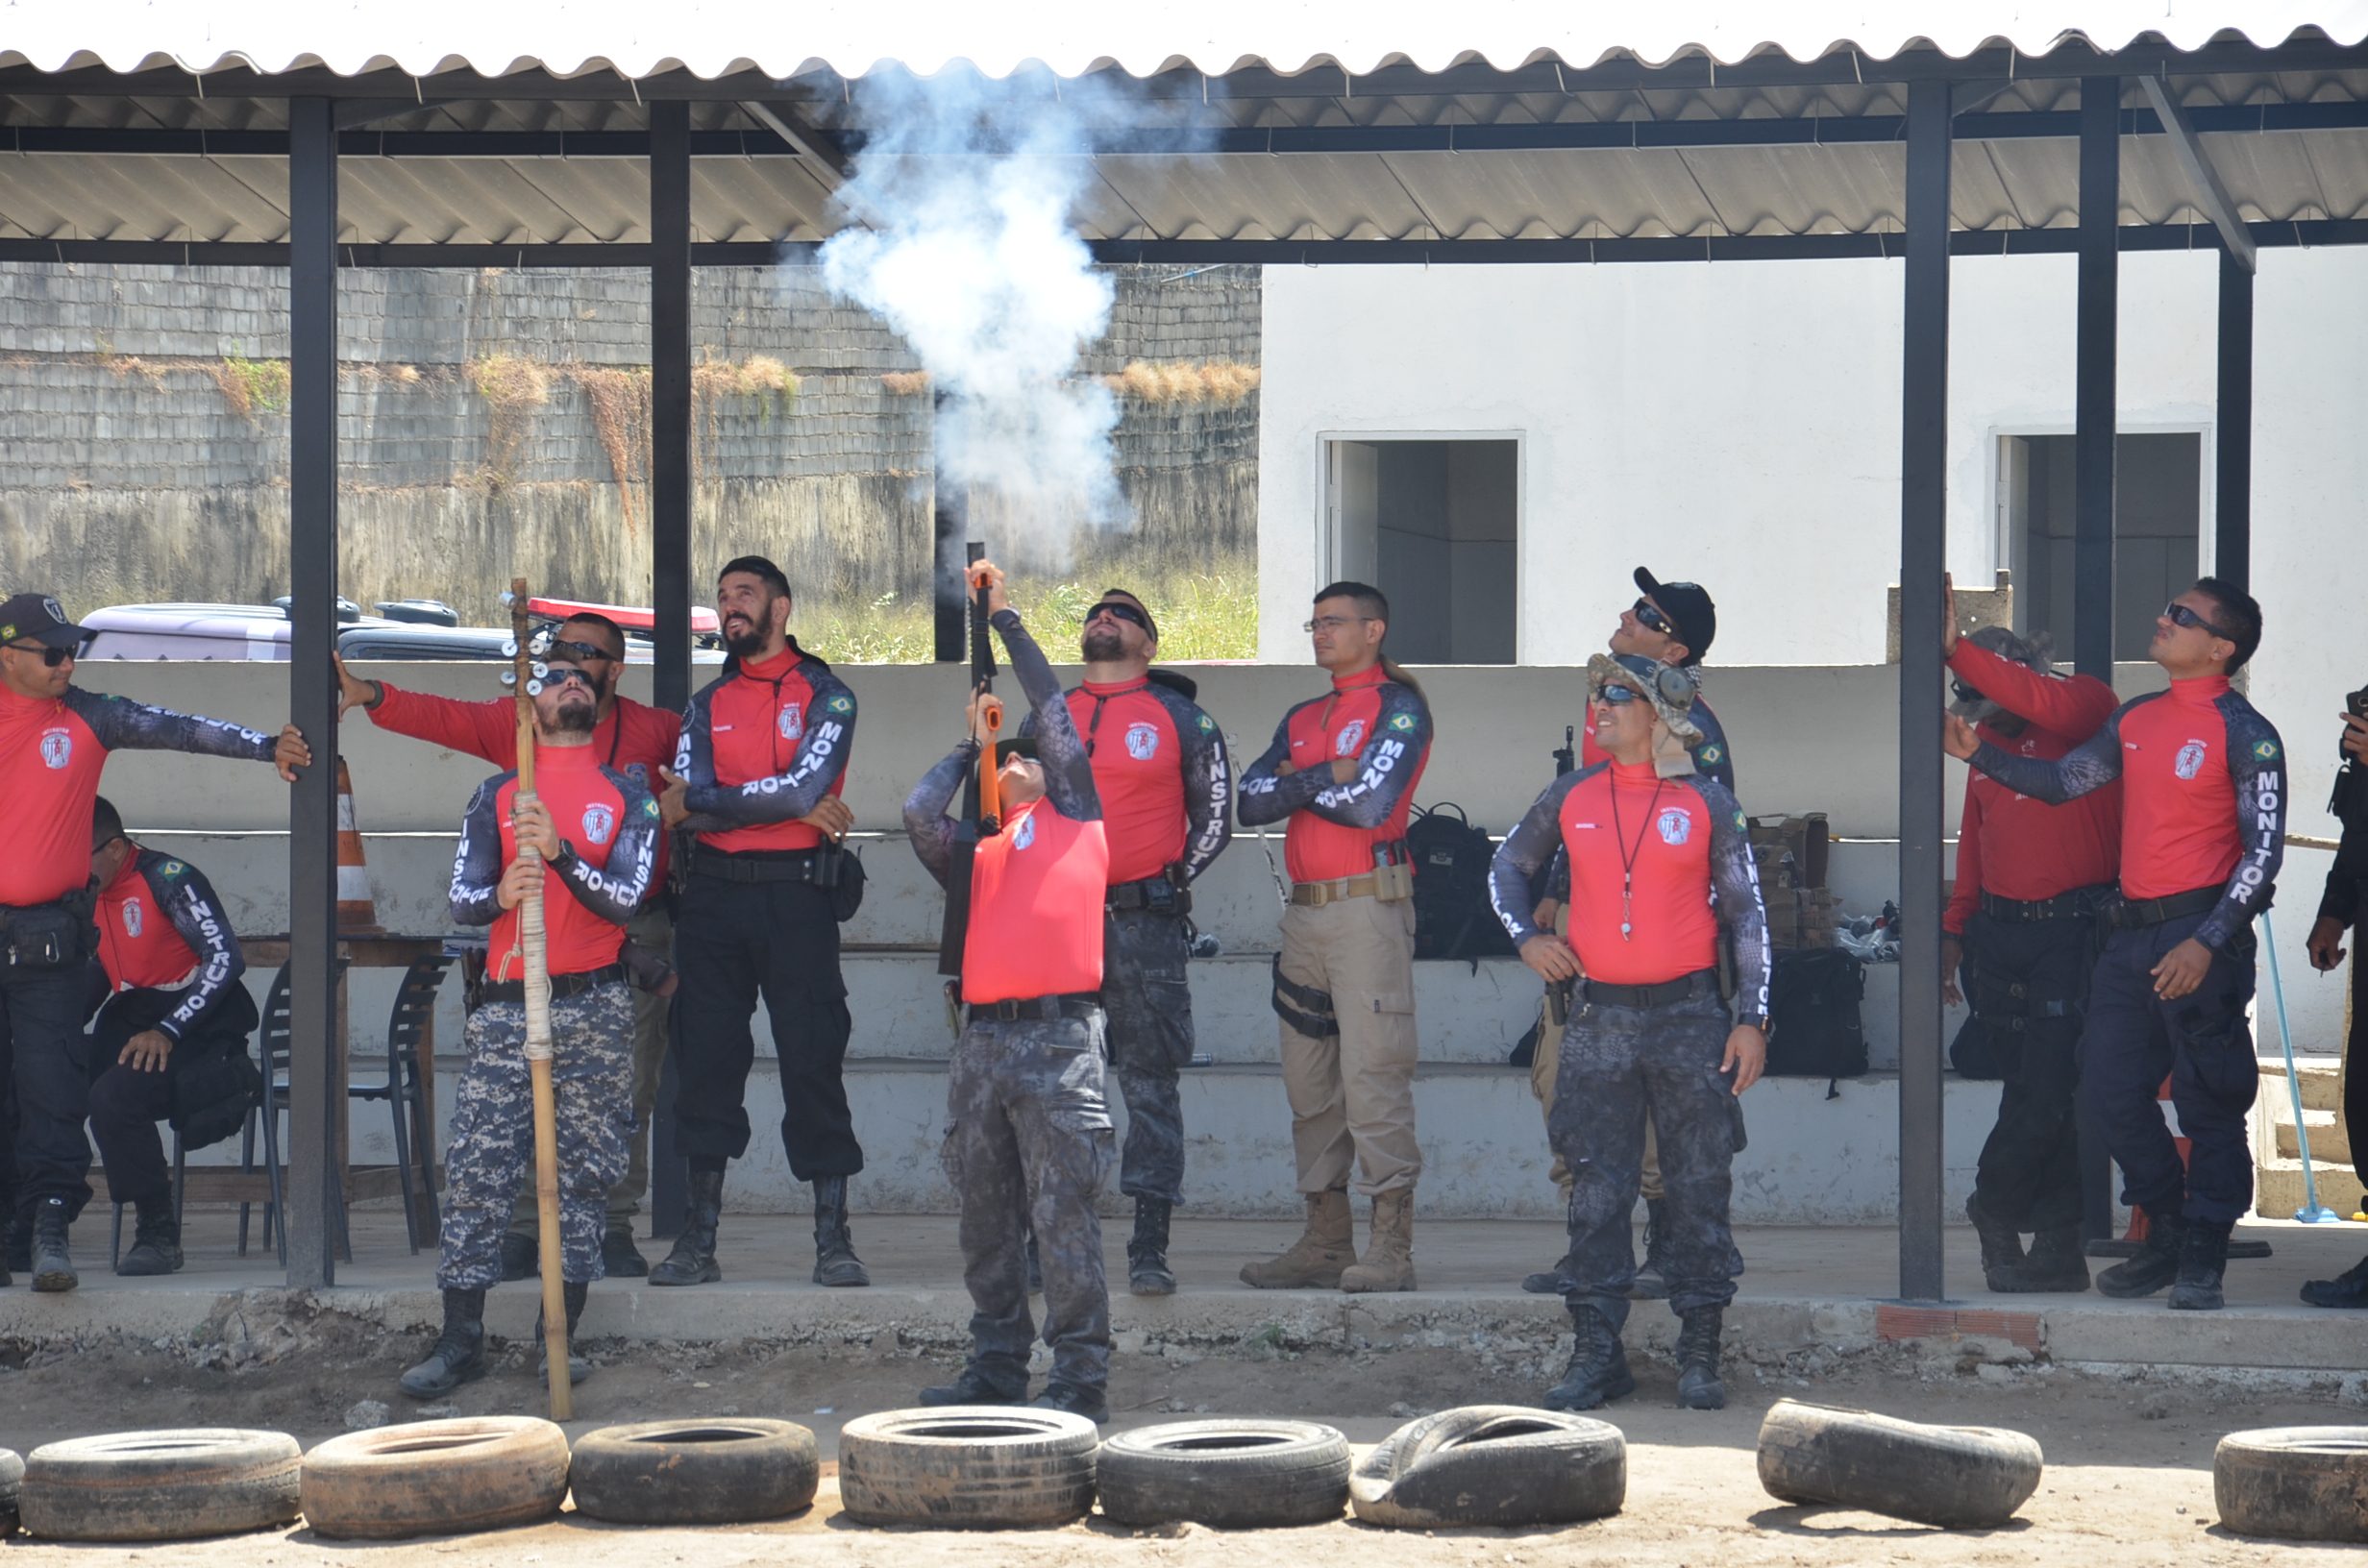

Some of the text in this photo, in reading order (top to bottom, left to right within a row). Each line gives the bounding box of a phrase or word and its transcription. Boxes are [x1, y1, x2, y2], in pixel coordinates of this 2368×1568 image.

[743, 722, 843, 796] MONITOR
[1315, 739, 1405, 809] MONITOR
[2230, 772, 2279, 905] MONITOR
[174, 884, 231, 1022] INSTRUTOR
